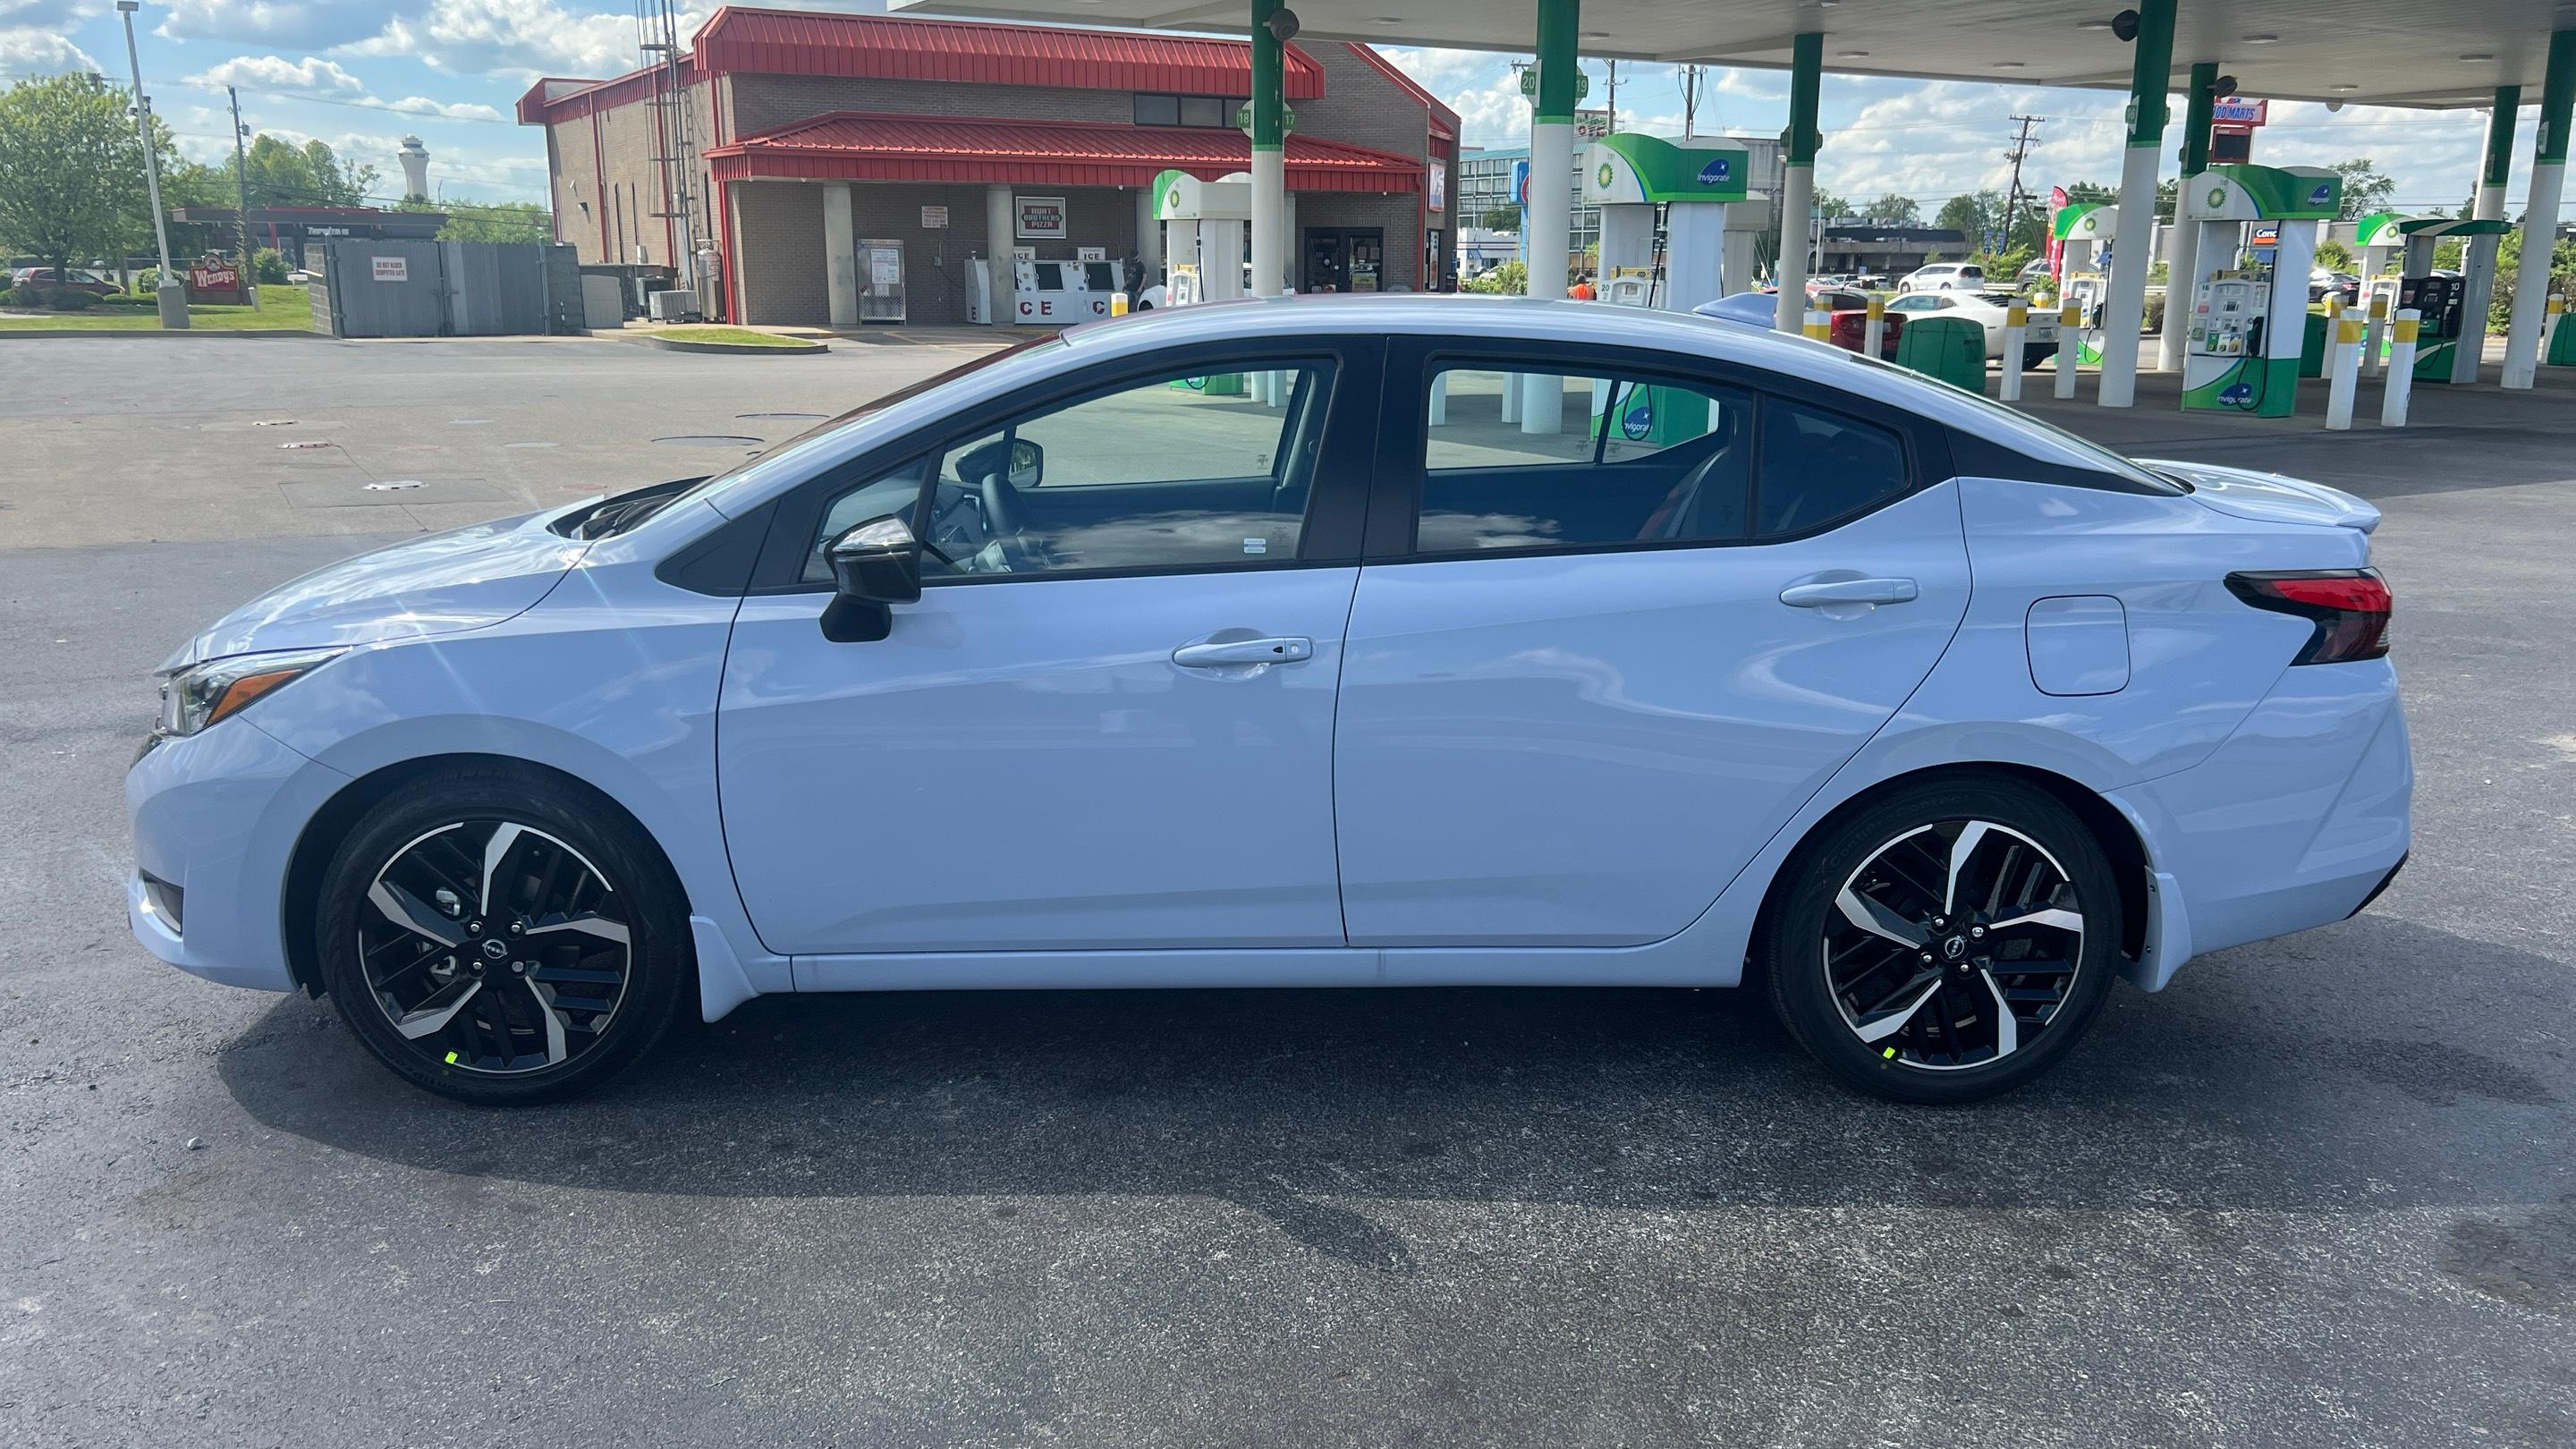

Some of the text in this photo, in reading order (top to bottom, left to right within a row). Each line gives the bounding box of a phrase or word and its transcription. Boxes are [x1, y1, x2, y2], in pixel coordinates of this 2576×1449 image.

[1521, 75, 1536, 89] 20
[1576, 79, 1589, 93] 19
[1238, 113, 1250, 124] 18
[2228, 106, 2256, 121] MARTS
[1285, 114, 1296, 125] 17
[1031, 207, 1052, 215] HUNT
[1084, 252, 1101, 260] ICE
[194, 269, 235, 287] Wendy's
[1600, 284, 1610, 292] 20
[2451, 282, 2461, 292] 10
